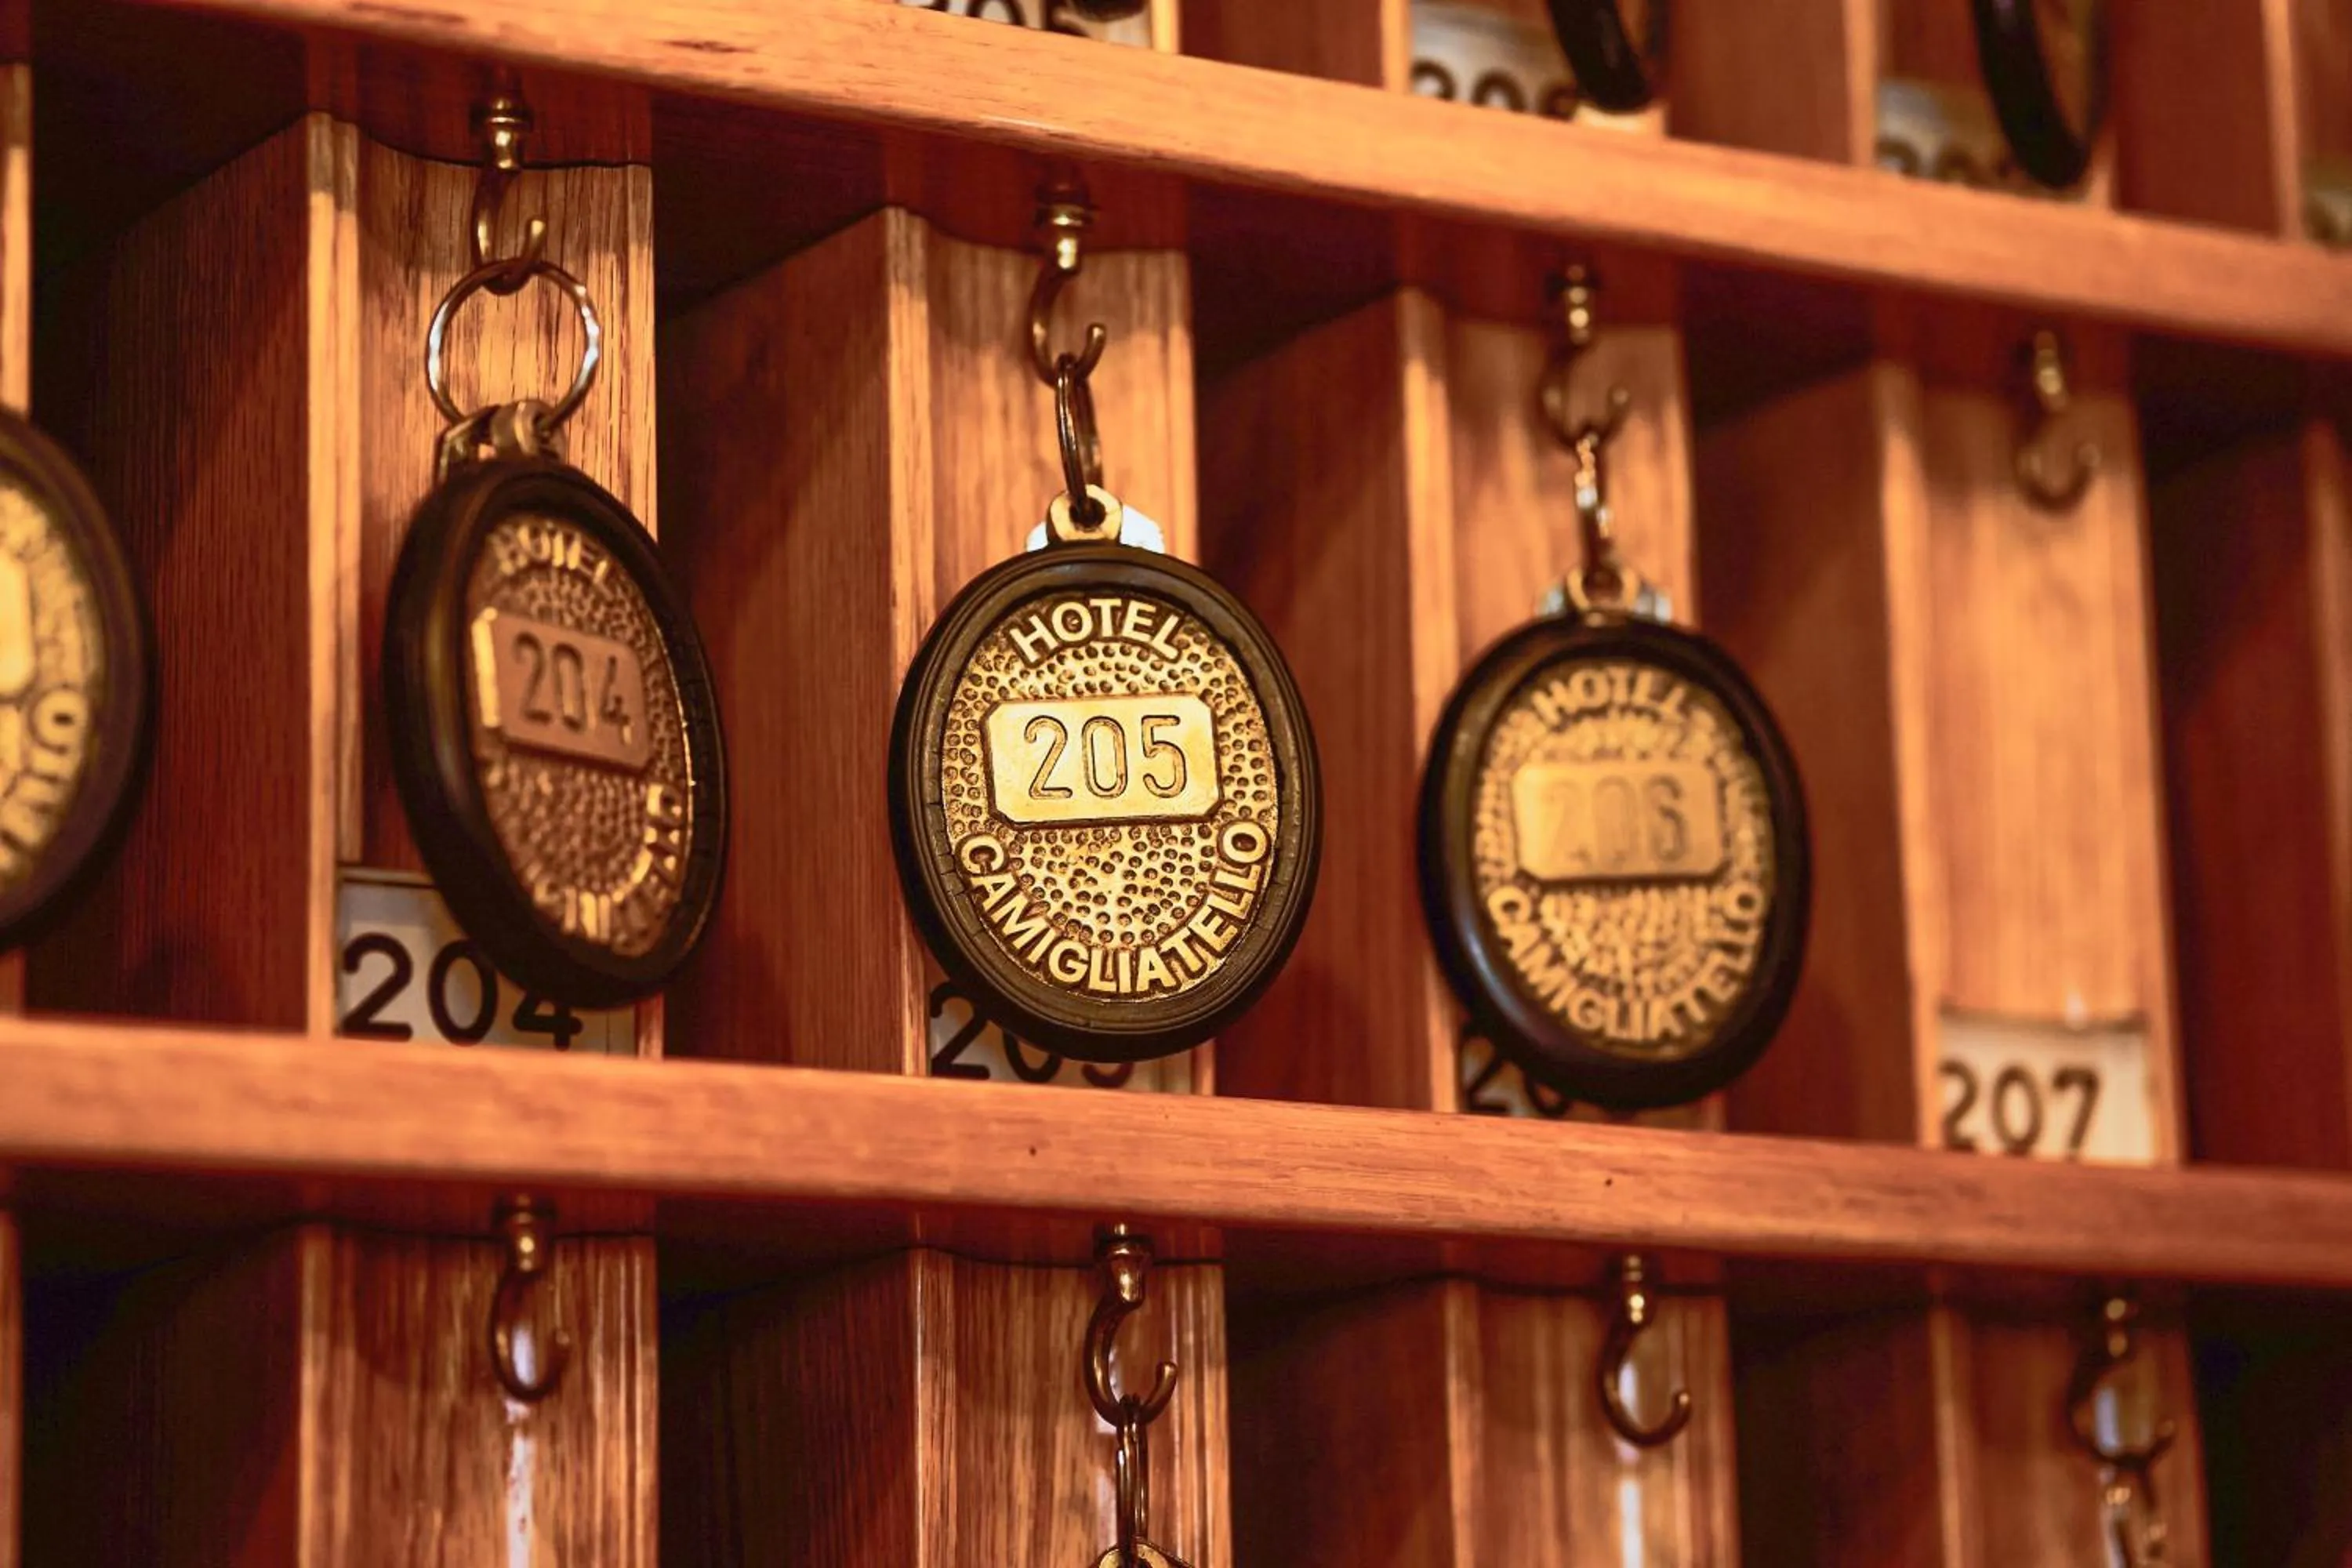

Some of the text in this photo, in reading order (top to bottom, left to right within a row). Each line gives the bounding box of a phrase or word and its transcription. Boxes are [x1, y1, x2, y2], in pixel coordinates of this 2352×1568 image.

[1009, 597, 1181, 663] HOTEL
[514, 631, 632, 746] 204
[1022, 715, 1188, 800] 205
[958, 820, 1268, 994] CAMIGLIATELLO
[340, 933, 583, 1051] 204
[1939, 1060, 2100, 1161] 207
